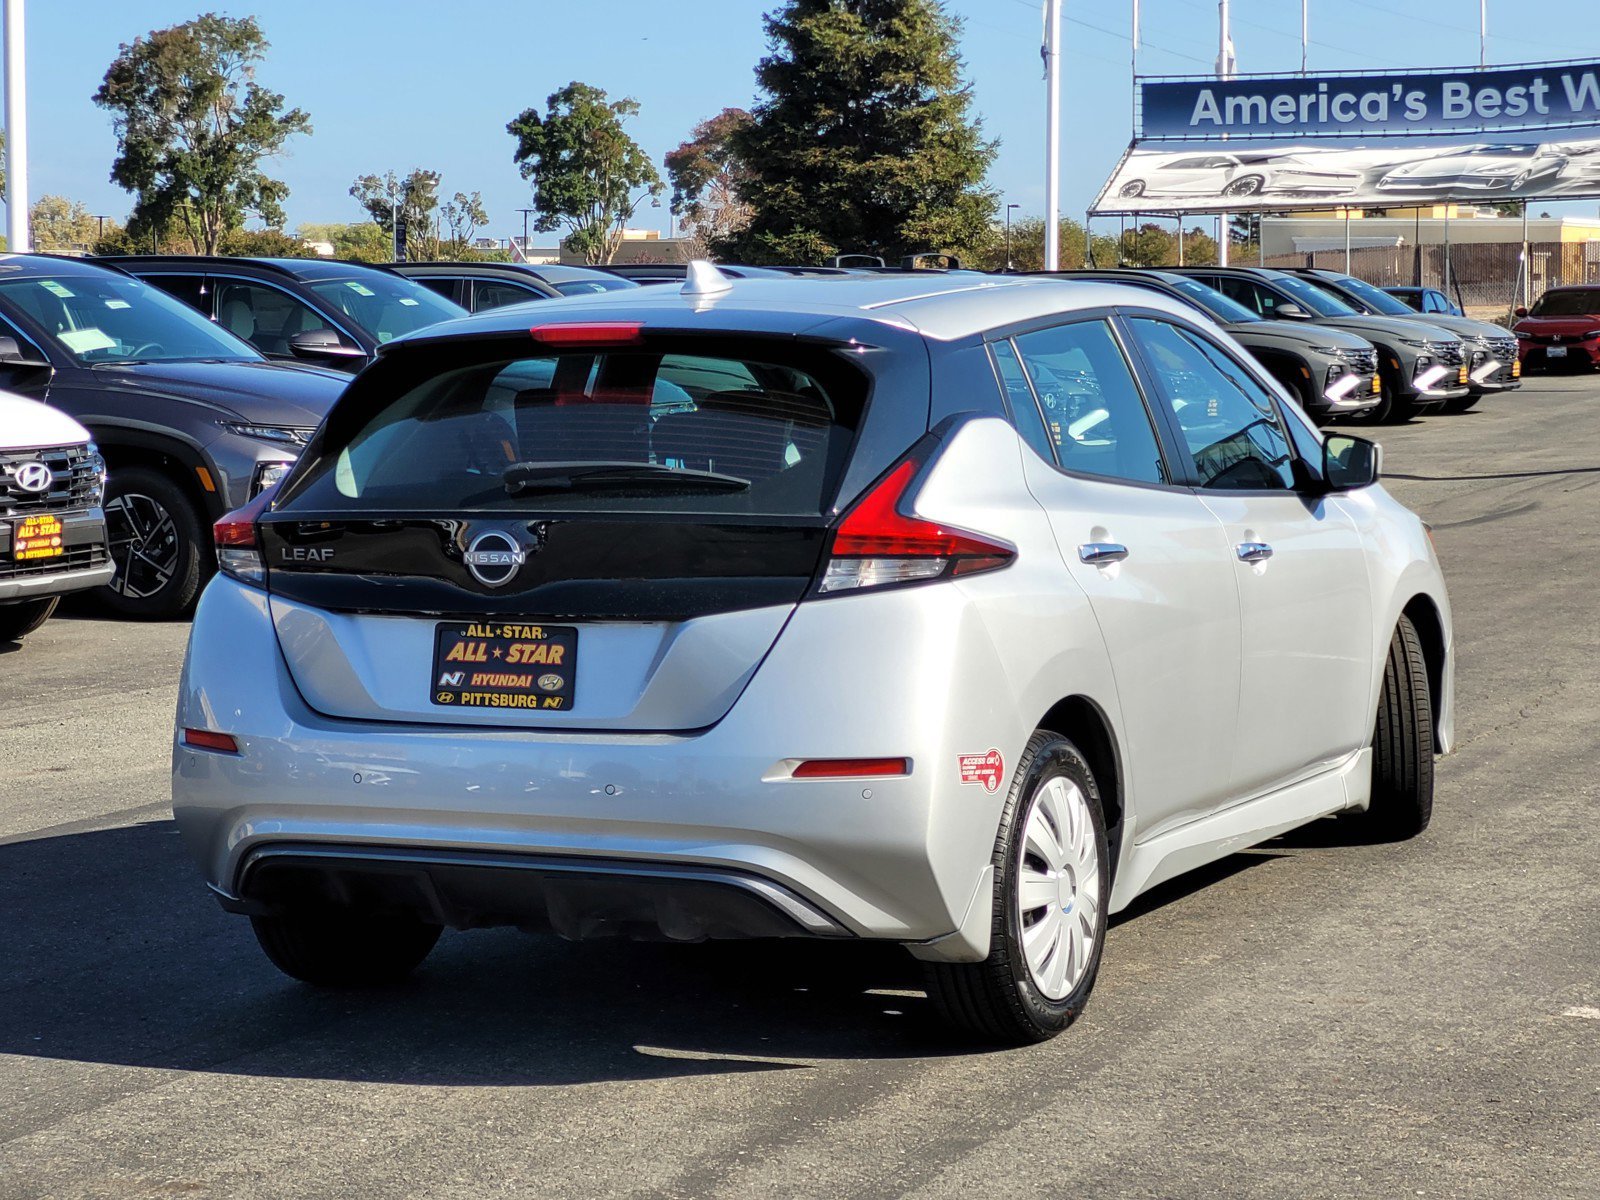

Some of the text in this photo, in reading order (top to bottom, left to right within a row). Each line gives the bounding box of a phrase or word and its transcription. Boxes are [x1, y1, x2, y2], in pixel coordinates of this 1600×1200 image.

[1189, 82, 1428, 126] America's
[1442, 77, 1550, 120] Best
[18, 522, 61, 538] ALL STAR
[281, 547, 335, 561] LEAF
[464, 551, 524, 564] NISSAN
[466, 624, 543, 640] ALL STAR
[445, 641, 565, 665] ALL STAR
[470, 673, 534, 688] HYUNDAI
[461, 692, 537, 708] PITTSBURG
[962, 757, 986, 765] ACCESS
